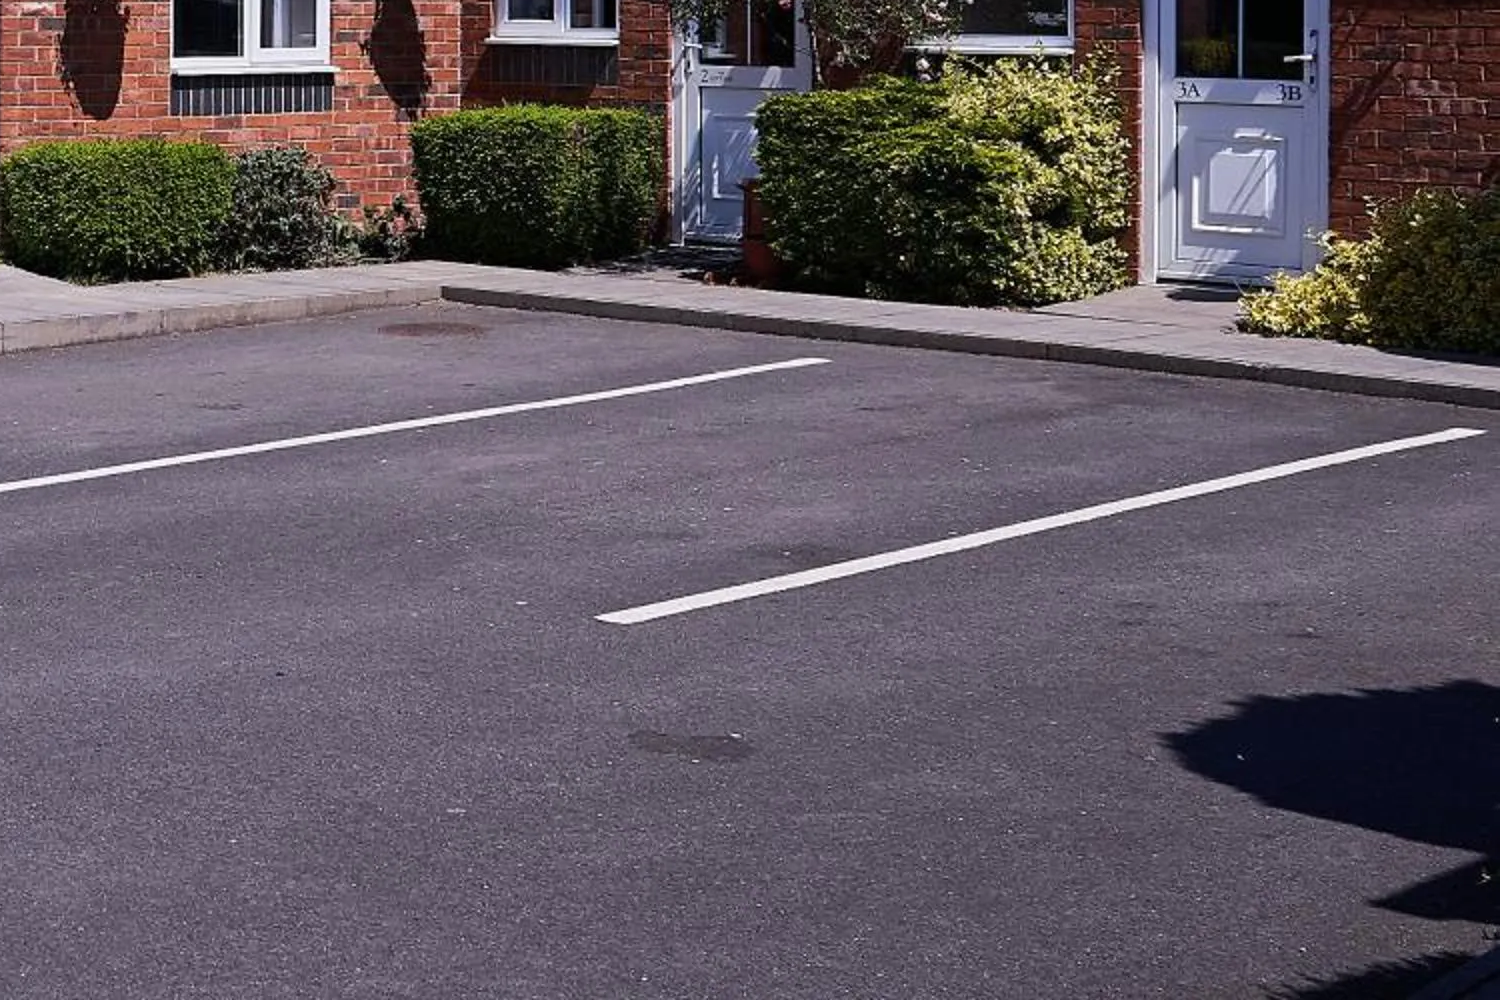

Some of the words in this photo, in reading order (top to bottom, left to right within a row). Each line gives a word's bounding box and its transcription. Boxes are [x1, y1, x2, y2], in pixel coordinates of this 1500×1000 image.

[701, 69, 709, 82] 2
[1177, 81, 1200, 98] 3A
[1276, 83, 1302, 101] 3B
